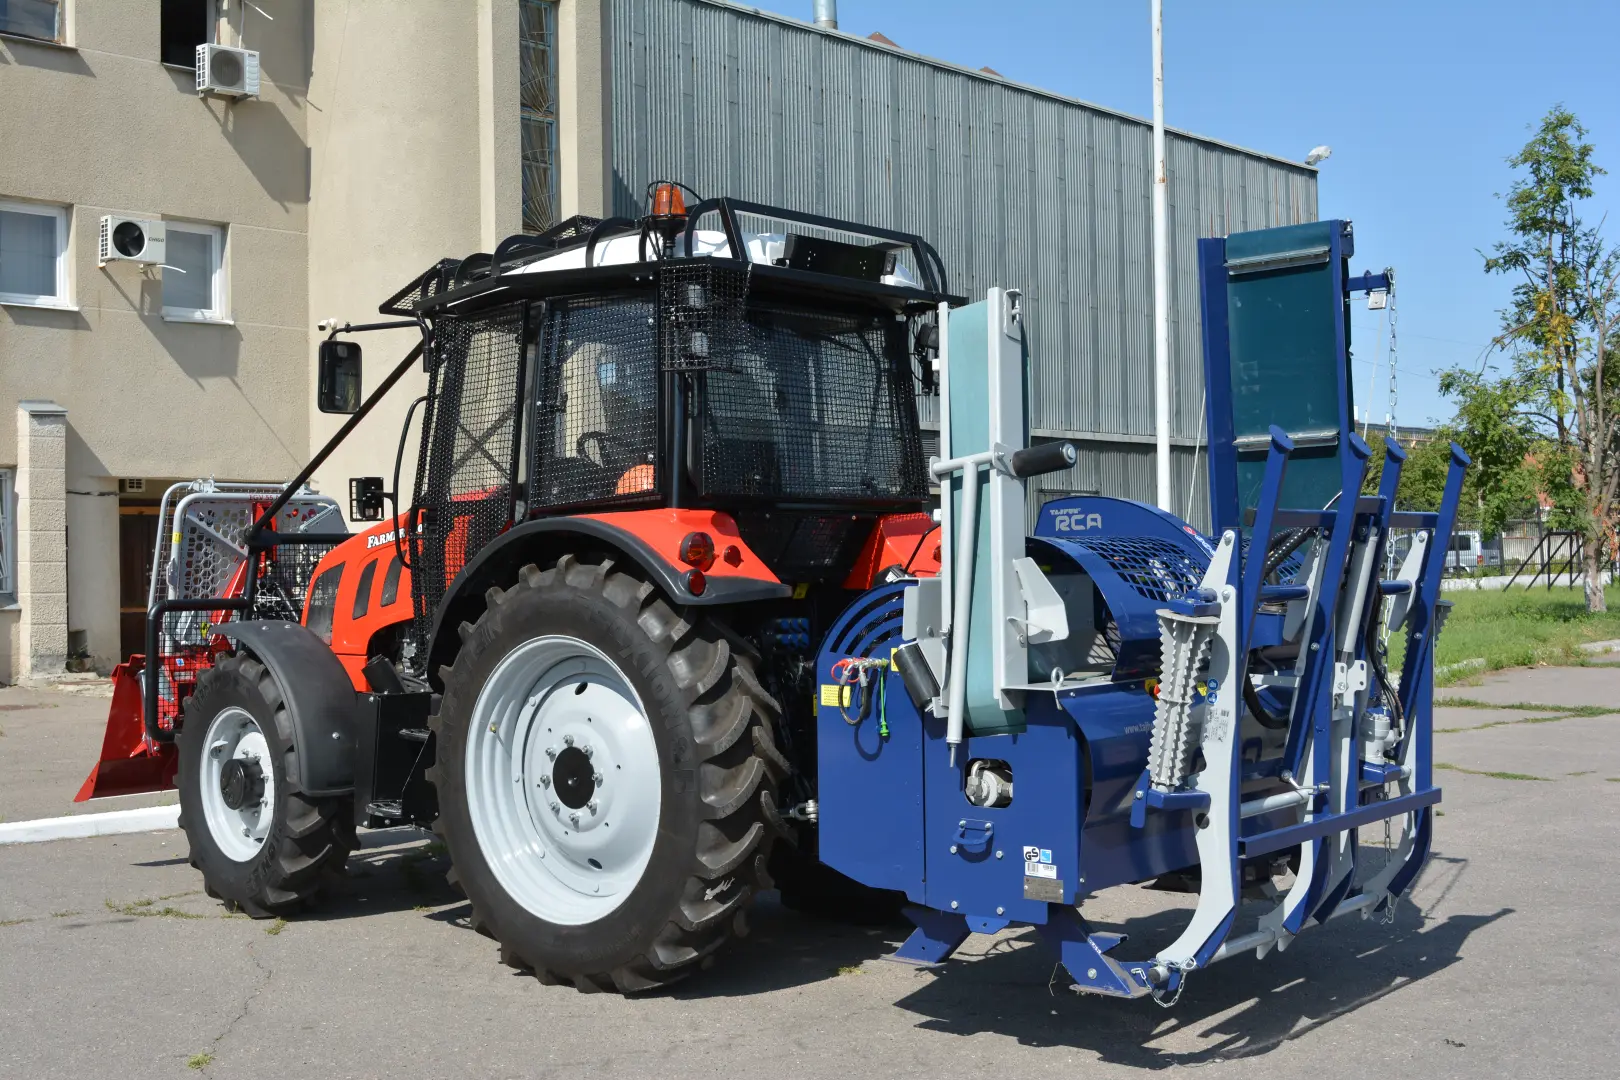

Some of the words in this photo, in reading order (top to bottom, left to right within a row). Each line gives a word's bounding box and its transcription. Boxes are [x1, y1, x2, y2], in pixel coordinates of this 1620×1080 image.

[1055, 513, 1102, 532] RCA
[367, 527, 406, 549] FARMR
[1024, 848, 1039, 861] GS
